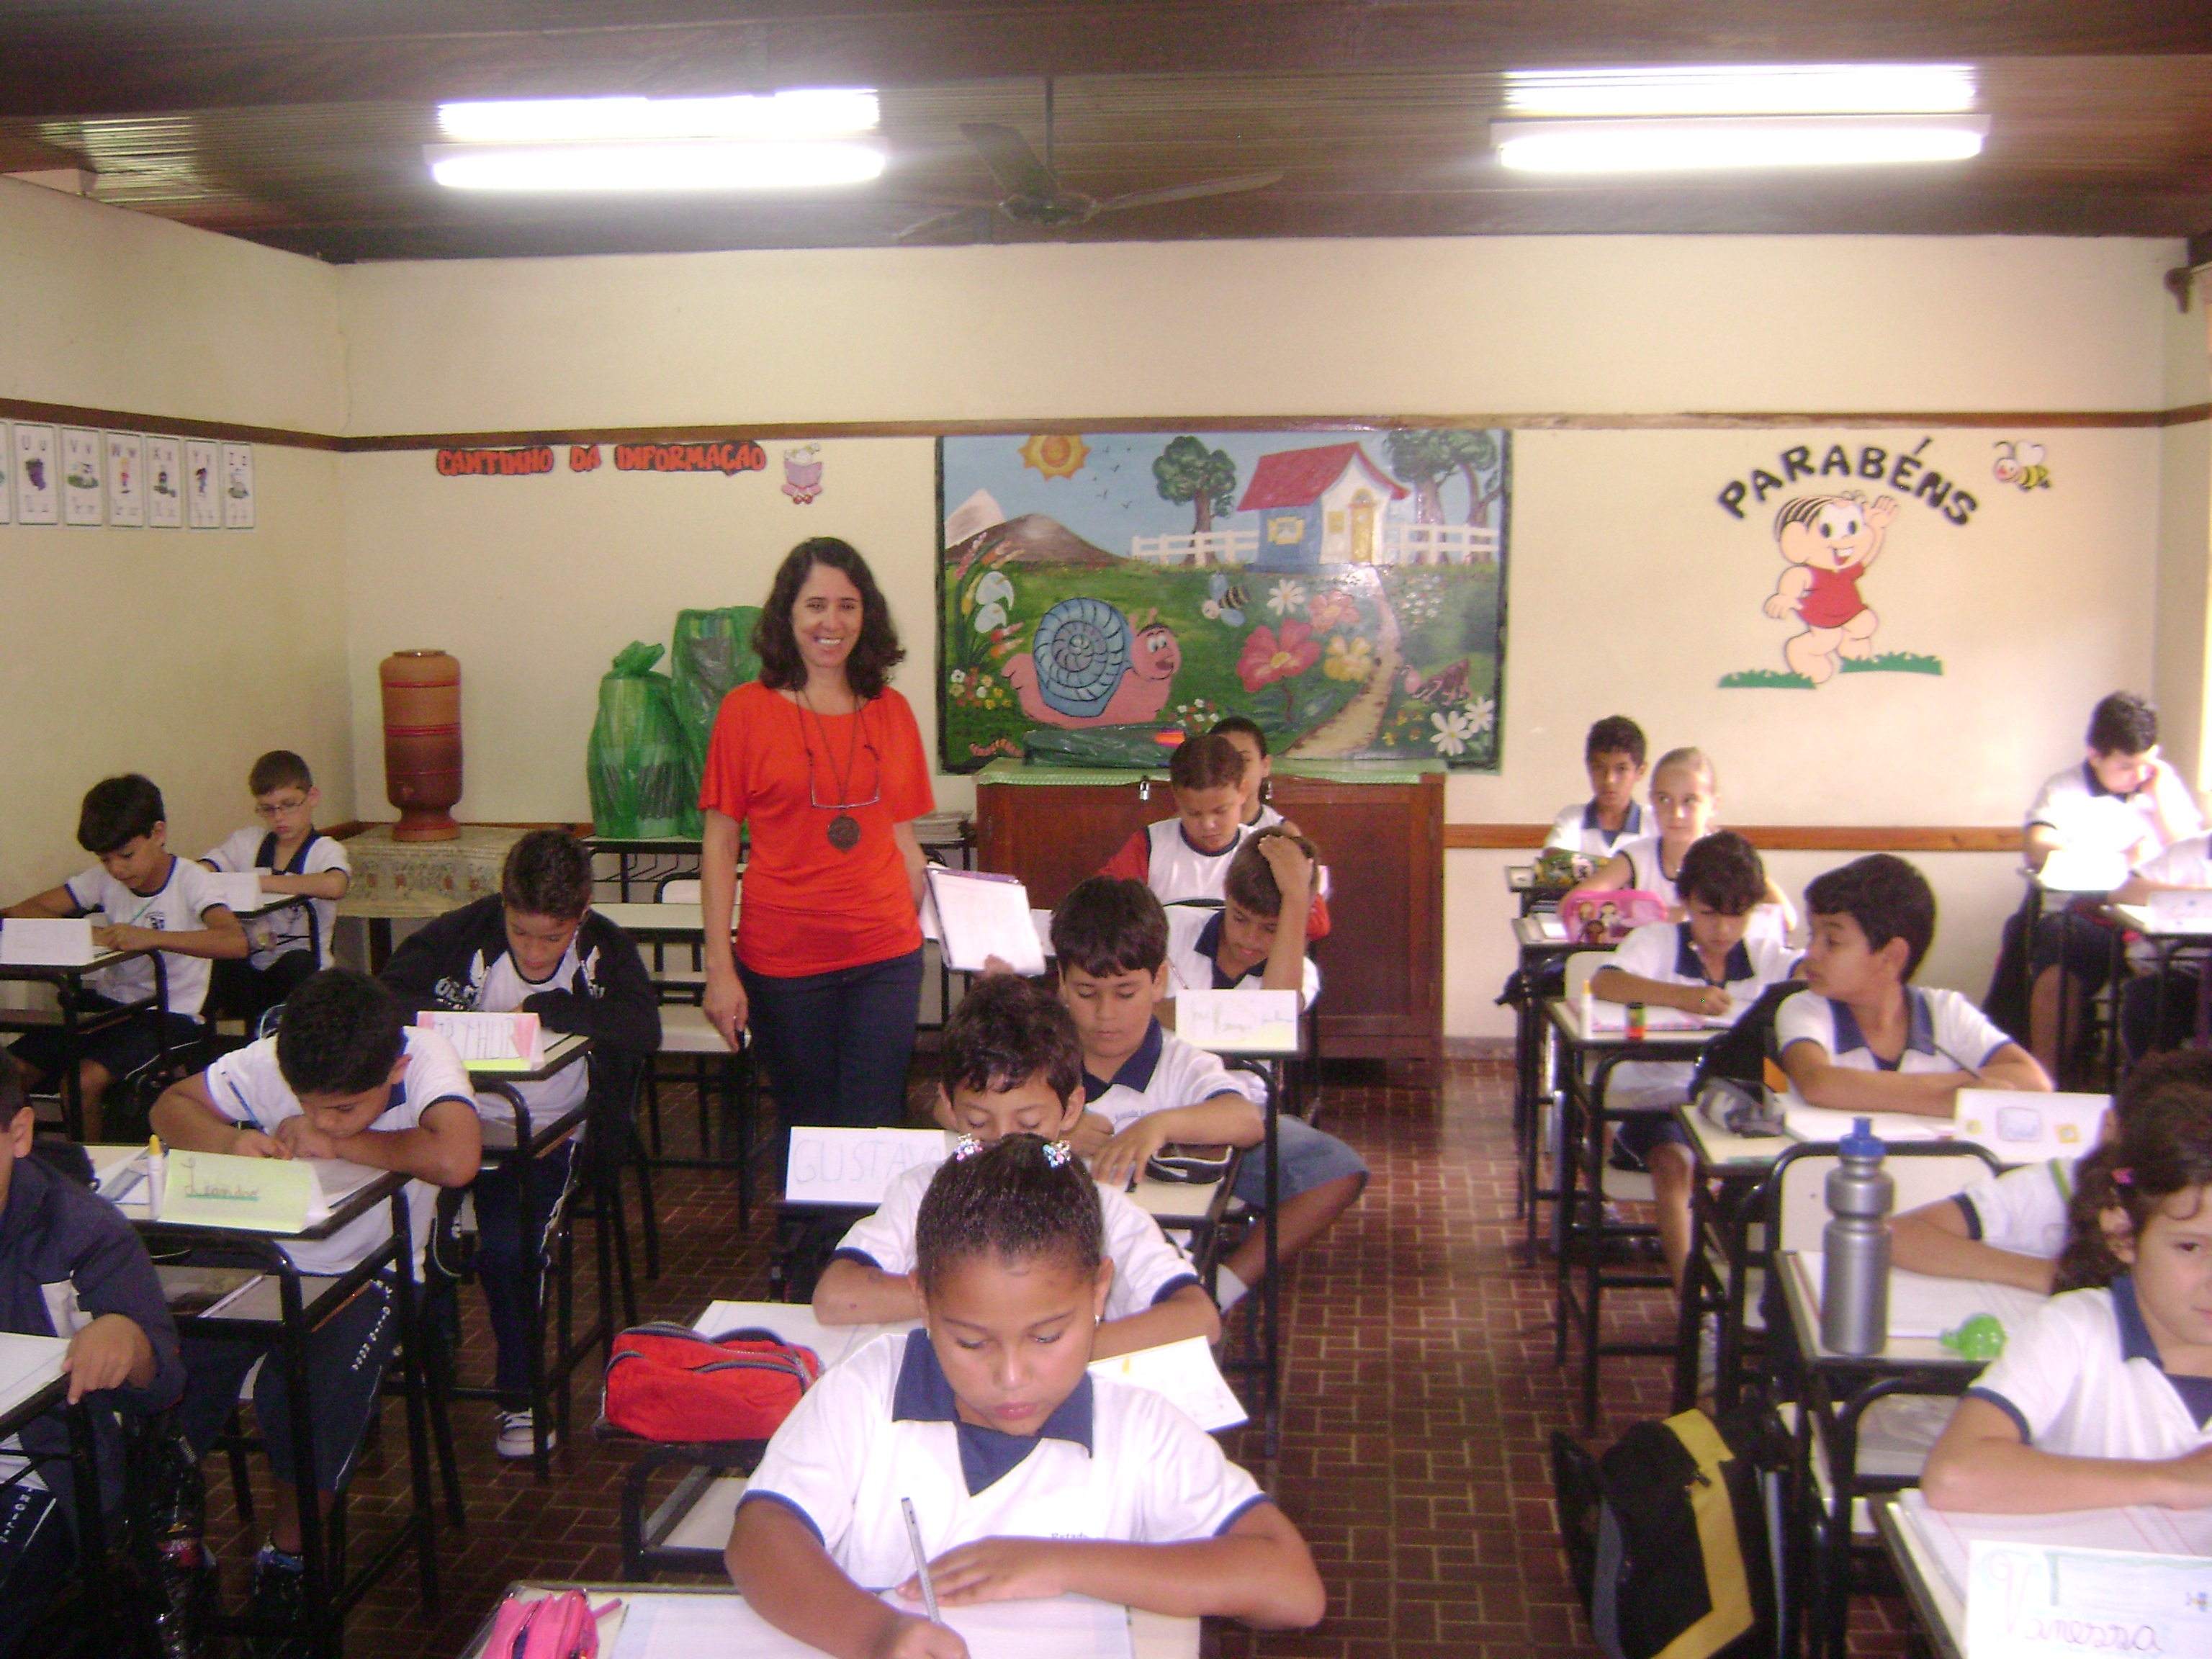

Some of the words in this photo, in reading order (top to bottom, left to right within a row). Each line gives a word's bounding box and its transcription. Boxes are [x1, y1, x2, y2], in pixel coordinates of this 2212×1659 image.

[437, 448, 552, 475] CANTINHO
[570, 445, 601, 472] DA
[1718, 436, 1978, 525] PARABÉNS
